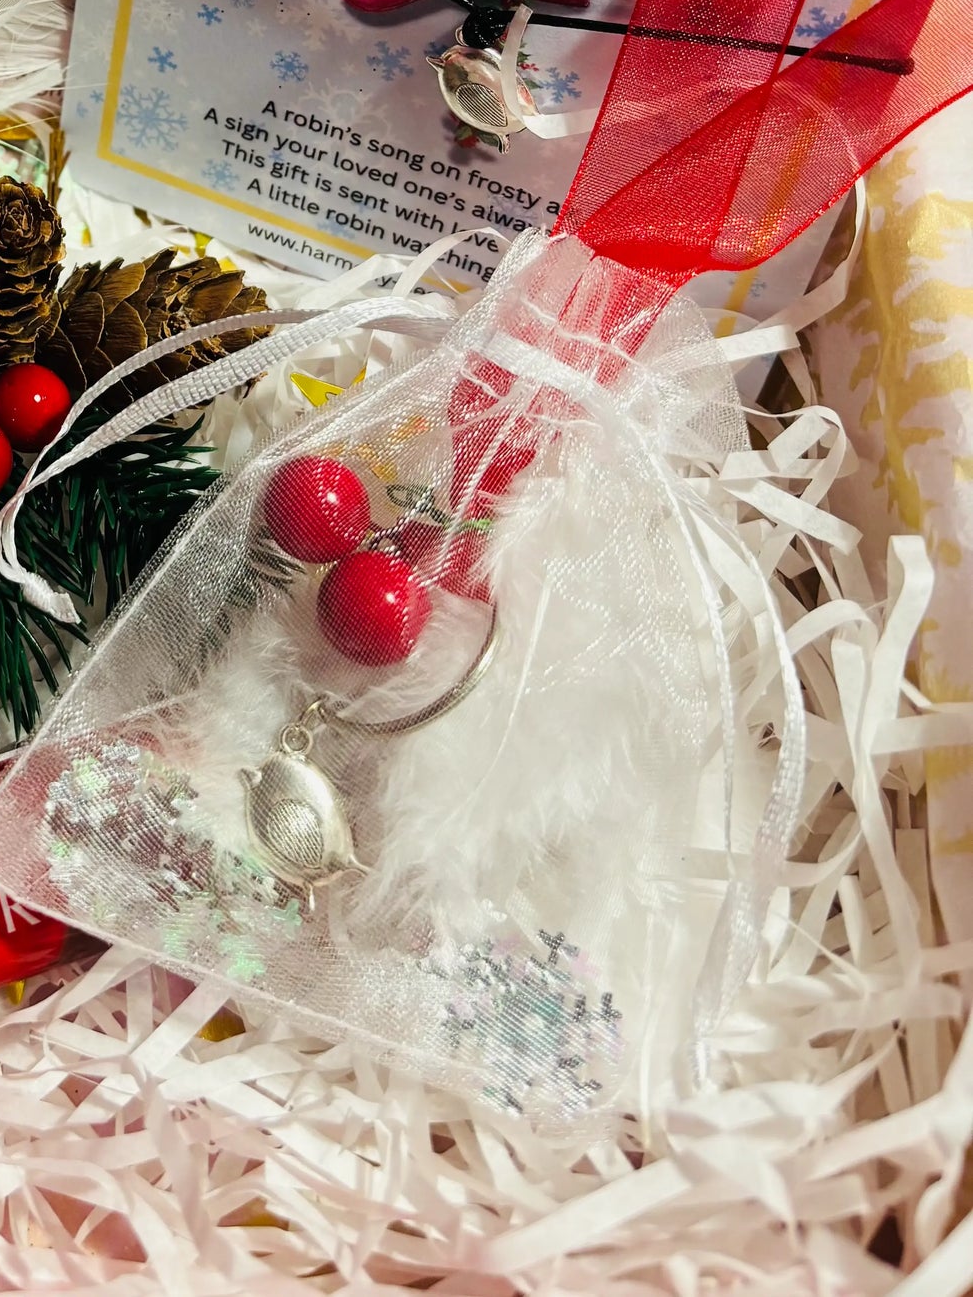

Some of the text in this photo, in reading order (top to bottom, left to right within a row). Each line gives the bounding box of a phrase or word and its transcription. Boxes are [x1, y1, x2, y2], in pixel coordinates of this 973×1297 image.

[204, 107, 219, 125] A
[224, 114, 269, 145] sign
[274, 131, 328, 163] your
[333, 151, 398, 187] loved
[472, 203, 552, 237] alwa
[221, 139, 499, 253] This gift is sent with lve
[261, 100, 278, 119] A
[367, 137, 426, 172] song
[430, 159, 461, 181] on
[467, 169, 542, 210] frosty
[247, 178, 495, 283] A little robin wahing
